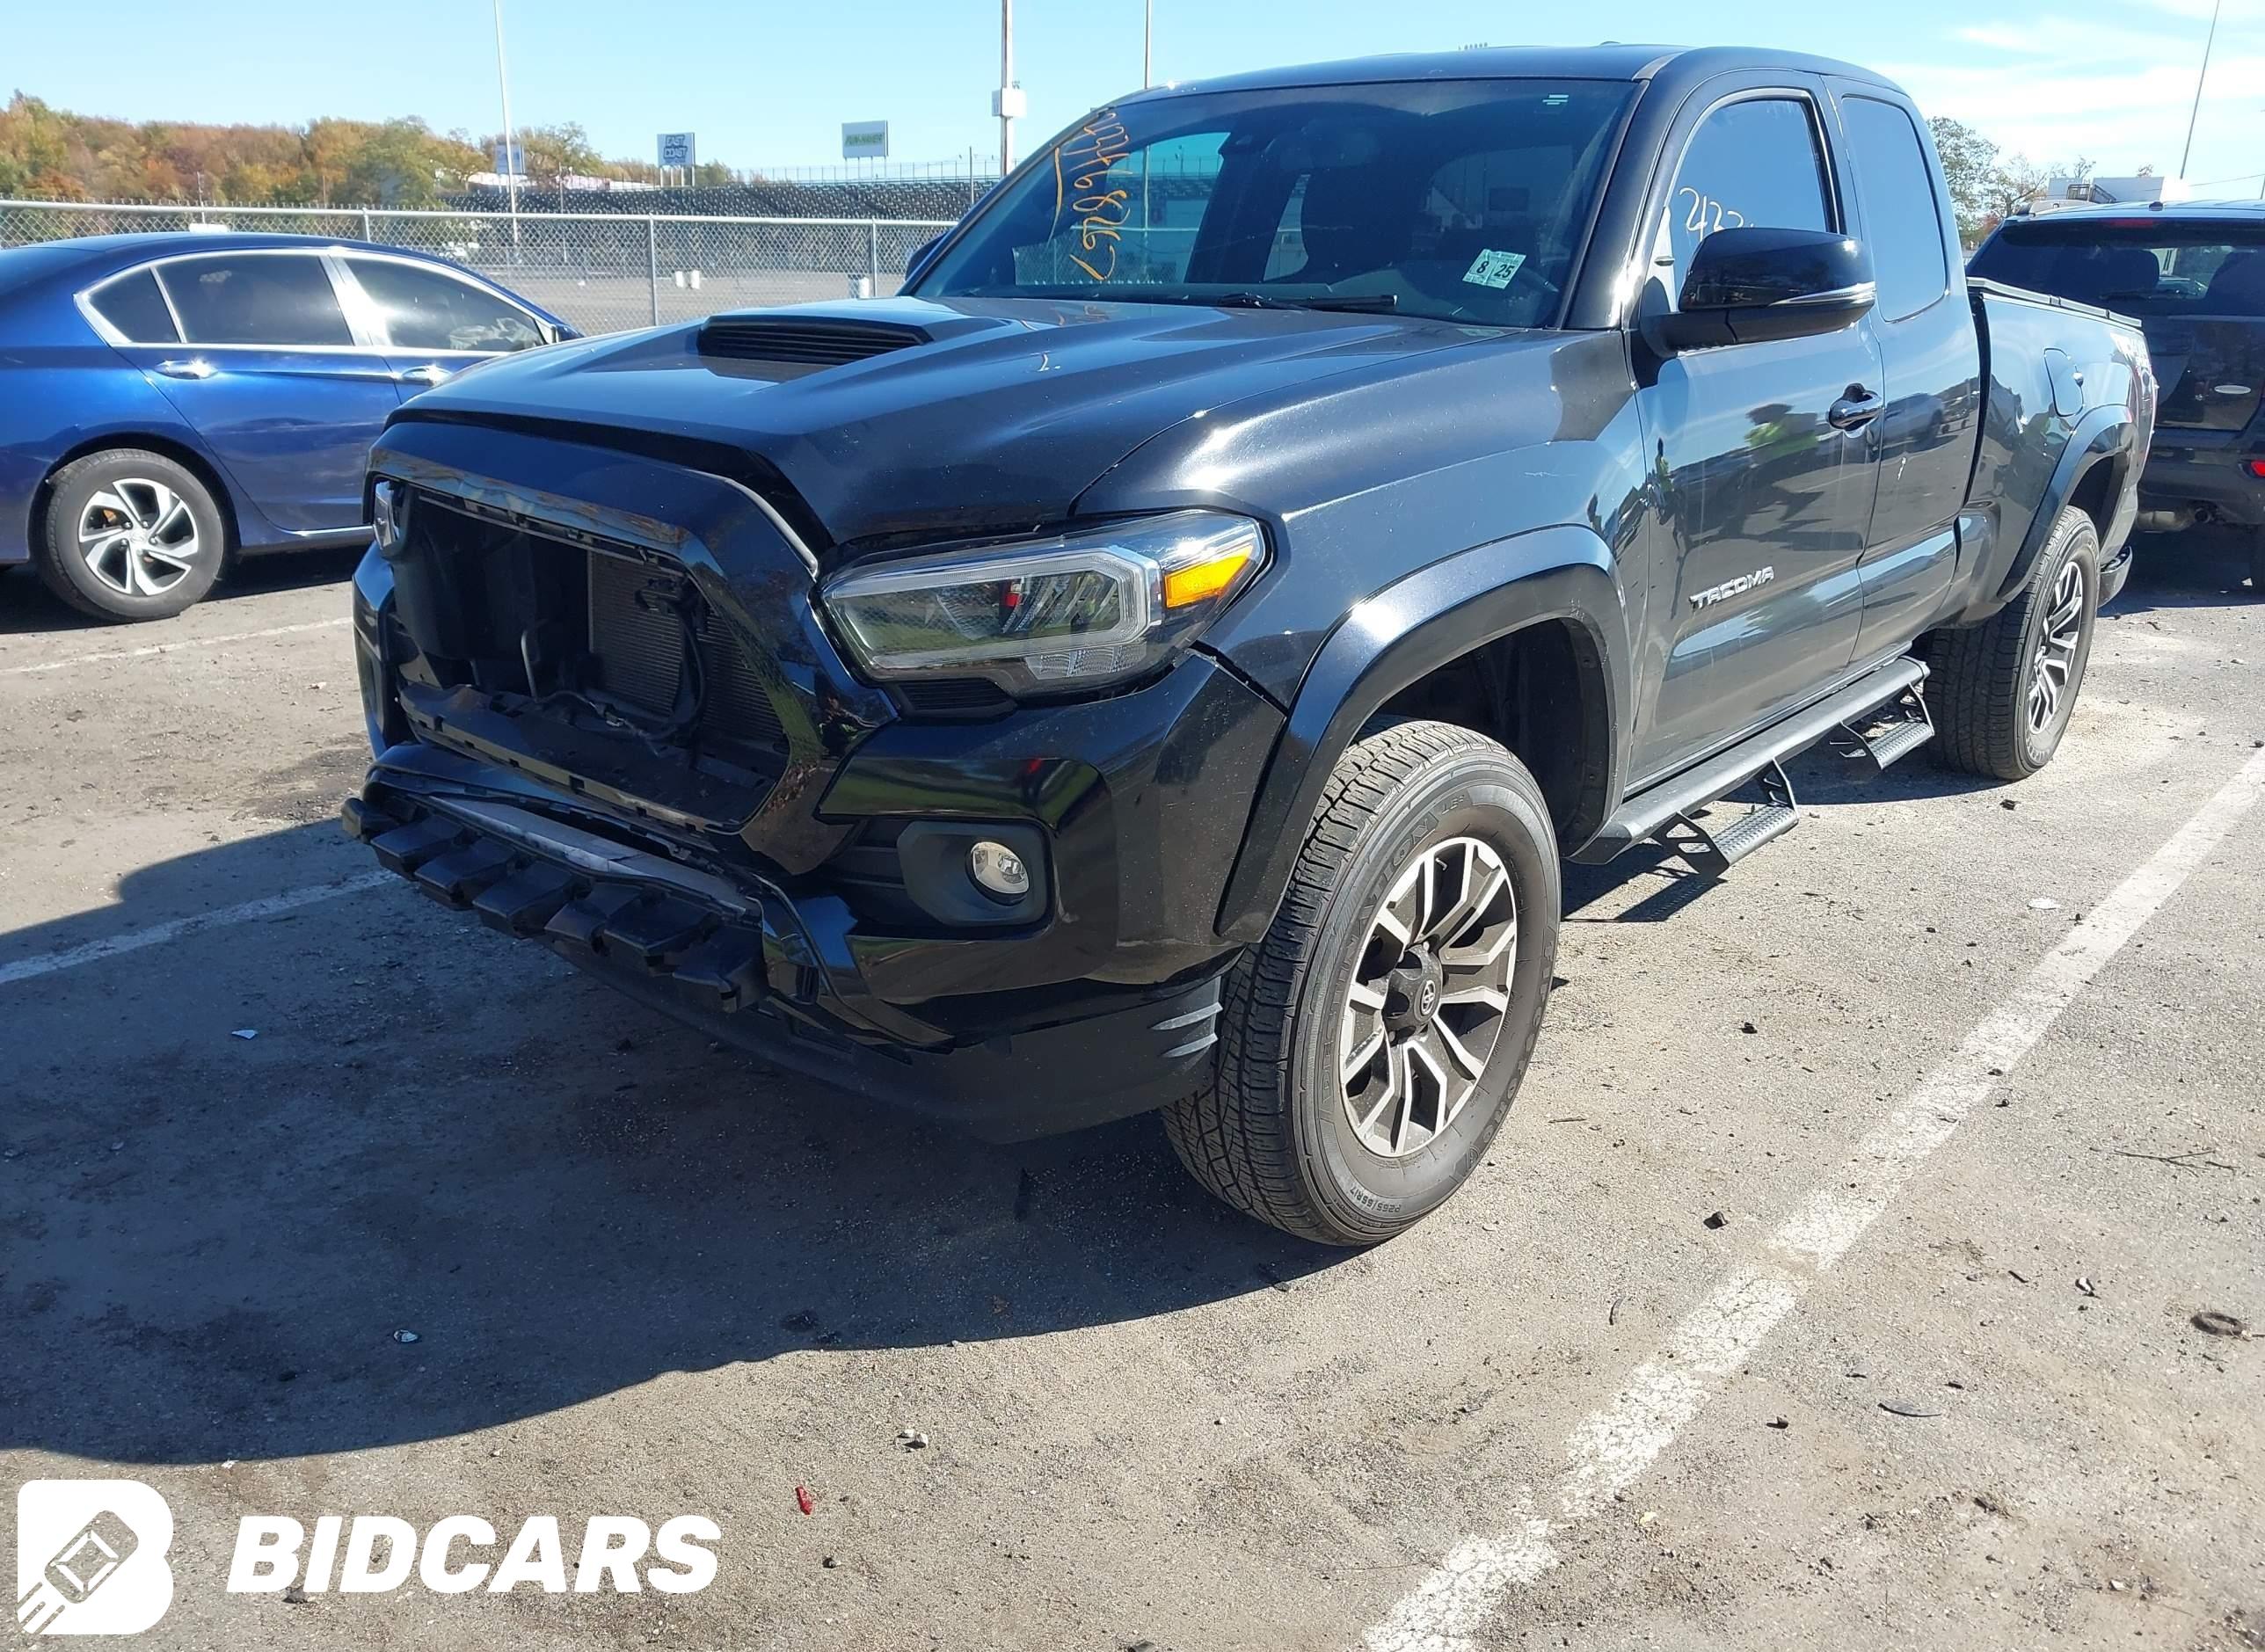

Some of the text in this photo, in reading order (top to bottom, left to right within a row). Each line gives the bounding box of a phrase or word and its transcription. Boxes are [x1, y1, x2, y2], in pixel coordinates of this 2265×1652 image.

[1476, 261, 1515, 278] 8 25
[1689, 565, 1774, 609] TACOMA
